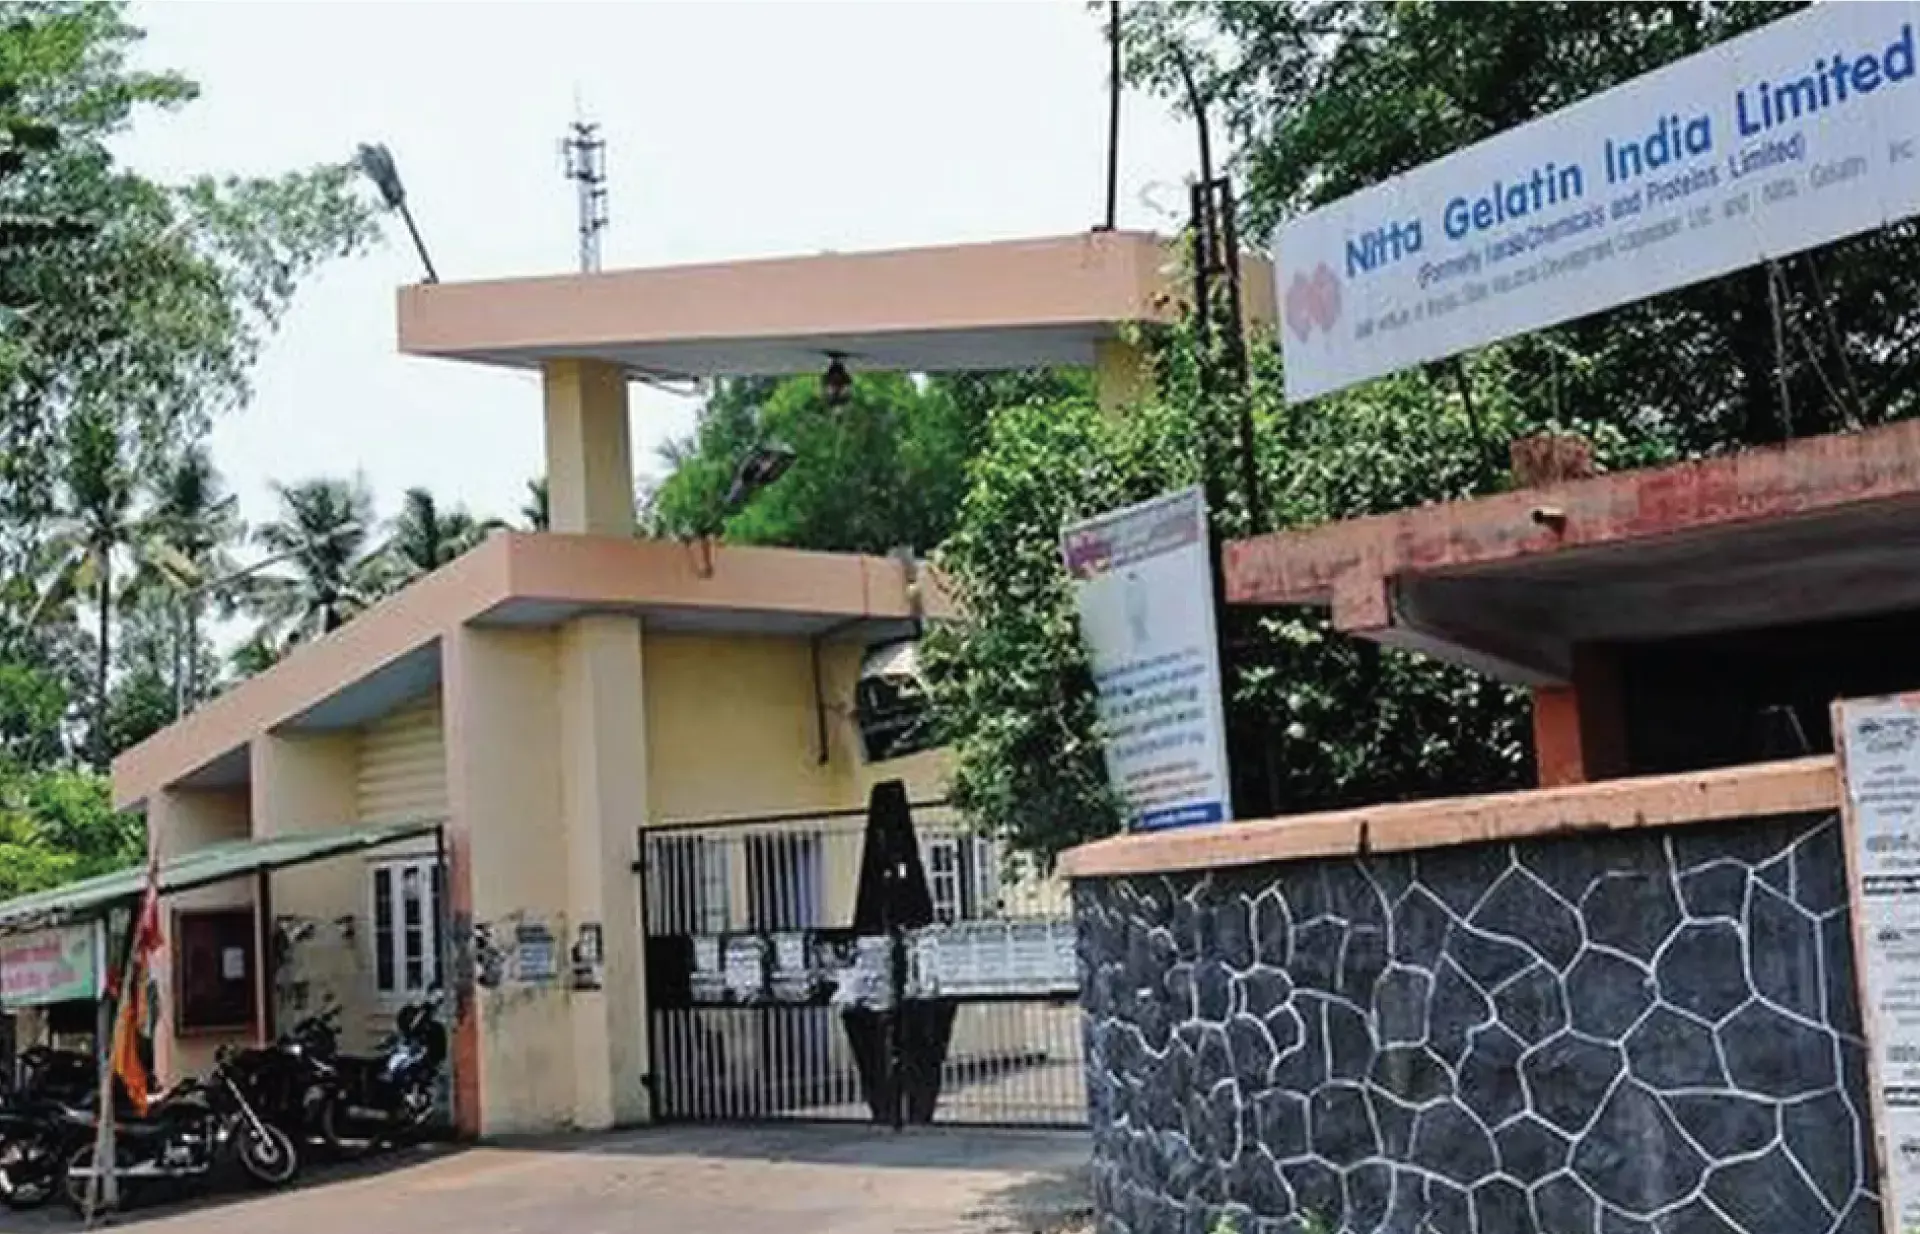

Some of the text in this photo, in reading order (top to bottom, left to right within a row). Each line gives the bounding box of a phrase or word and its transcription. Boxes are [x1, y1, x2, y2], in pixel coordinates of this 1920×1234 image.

[1346, 24, 1915, 278] Nitta Gelatin India Limited
